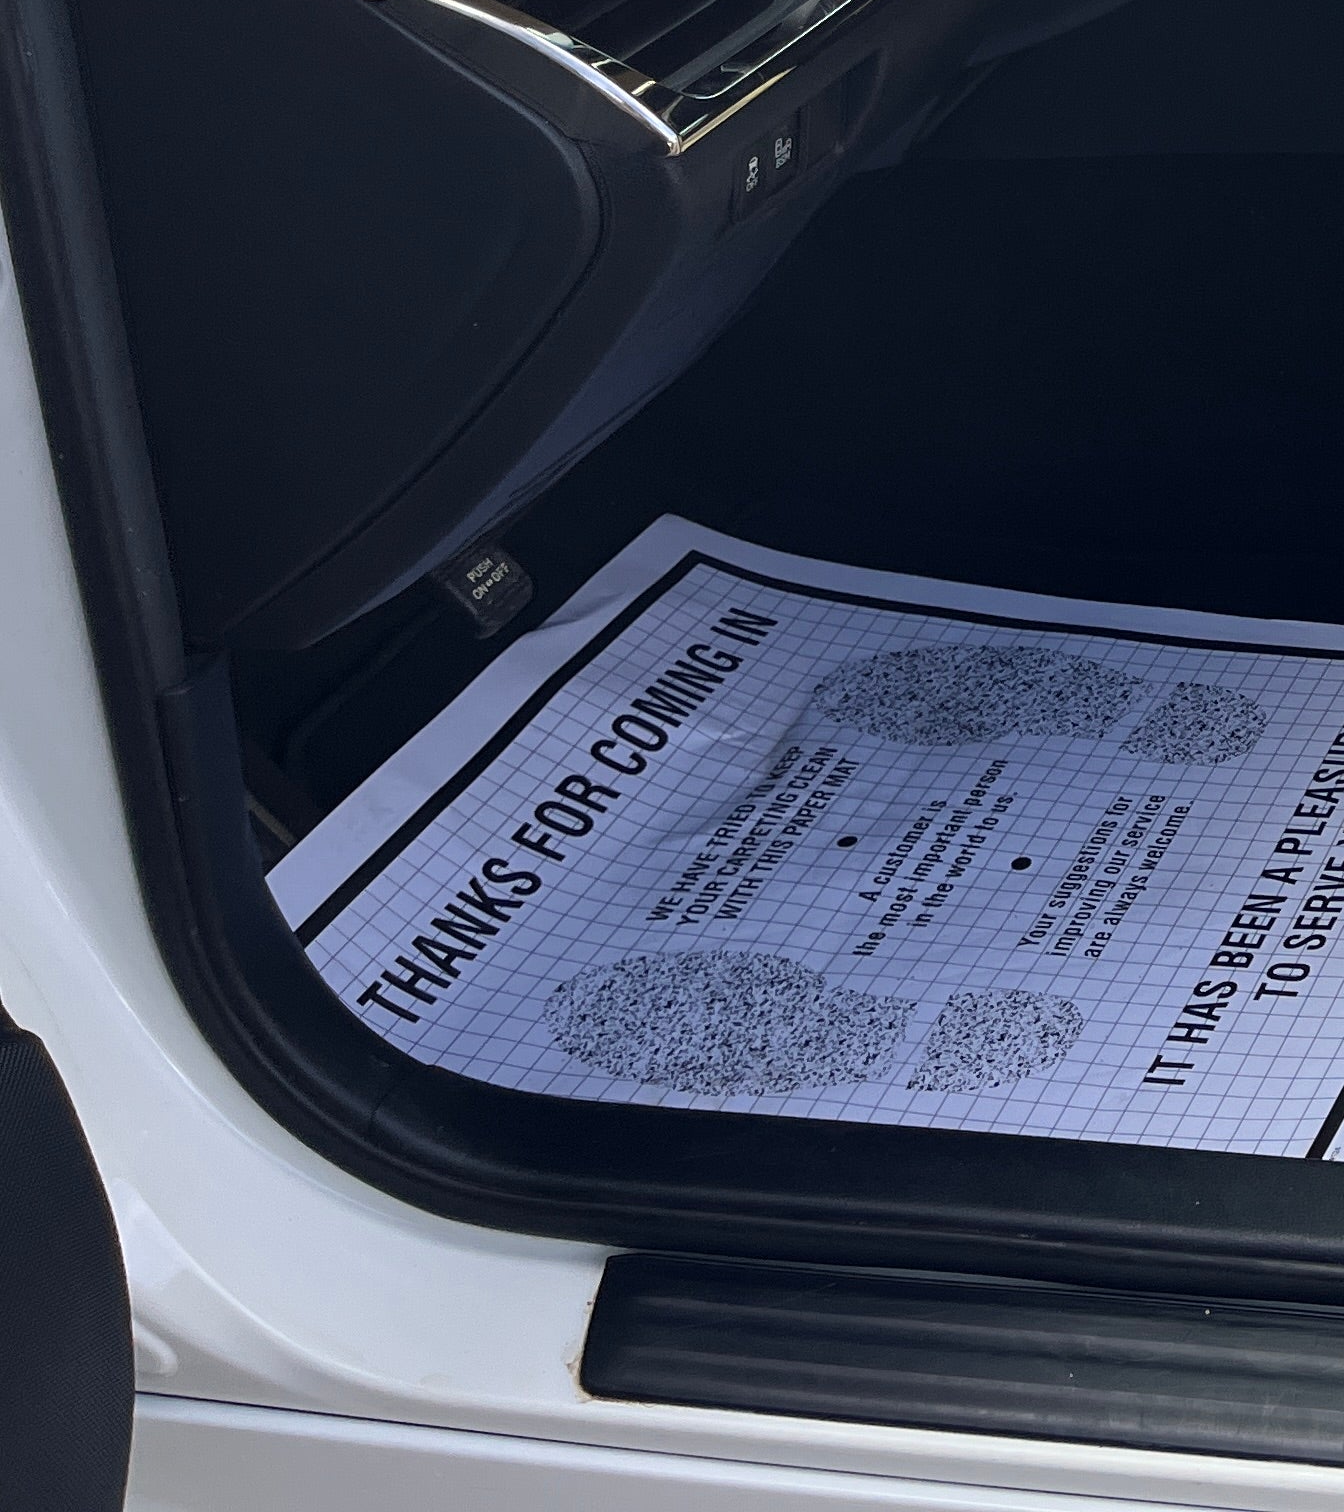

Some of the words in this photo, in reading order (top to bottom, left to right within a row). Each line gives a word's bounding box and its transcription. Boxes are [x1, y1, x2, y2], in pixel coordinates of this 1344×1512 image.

[466, 557, 494, 583] PUSH
[356, 857, 542, 1024] THANKS
[510, 774, 622, 862] FOR
[590, 643, 744, 776] COMING
[710, 607, 778, 646] IN
[645, 896, 683, 921] WE
[671, 852, 720, 893] HAVE
[706, 804, 757, 846] TRIED
[746, 784, 776, 798] TO
[769, 746, 804, 780] KEEP
[675, 880, 729, 926] YOUR
[716, 791, 798, 876] CARPETING
[787, 747, 838, 790] CLEAN
[973, 817, 1000, 831] to
[991, 791, 1018, 813] us.
[713, 877, 764, 919] WITH
[749, 840, 794, 873] THIS
[781, 790, 836, 836] PAPER
[821, 757, 860, 787] MAT
[852, 932, 887, 956] the
[878, 887, 918, 927] most
[903, 809, 973, 882] important
[963, 759, 1009, 807] person
[858, 891, 882, 903] A
[873, 815, 934, 885] customer
[921, 800, 947, 812] is
[944, 834, 987, 878] world
[1017, 913, 1057, 947] Your
[1048, 820, 1118, 909] suggestions
[1106, 796, 1133, 816] for
[921, 882, 954, 908] the
[1045, 879, 1115, 957] improving
[1103, 849, 1131, 875] our
[1121, 795, 1166, 847] service
[1084, 931, 1113, 958] are
[1103, 875, 1149, 926] always
[1138, 800, 1194, 871] welcome.
[1260, 866, 1304, 885] A
[912, 913, 934, 928] in
[1210, 893, 1288, 969] BEEN
[1167, 980, 1238, 1044] HAS
[1253, 962, 1311, 1001] TO
[1144, 1054, 1195, 1086] IT
